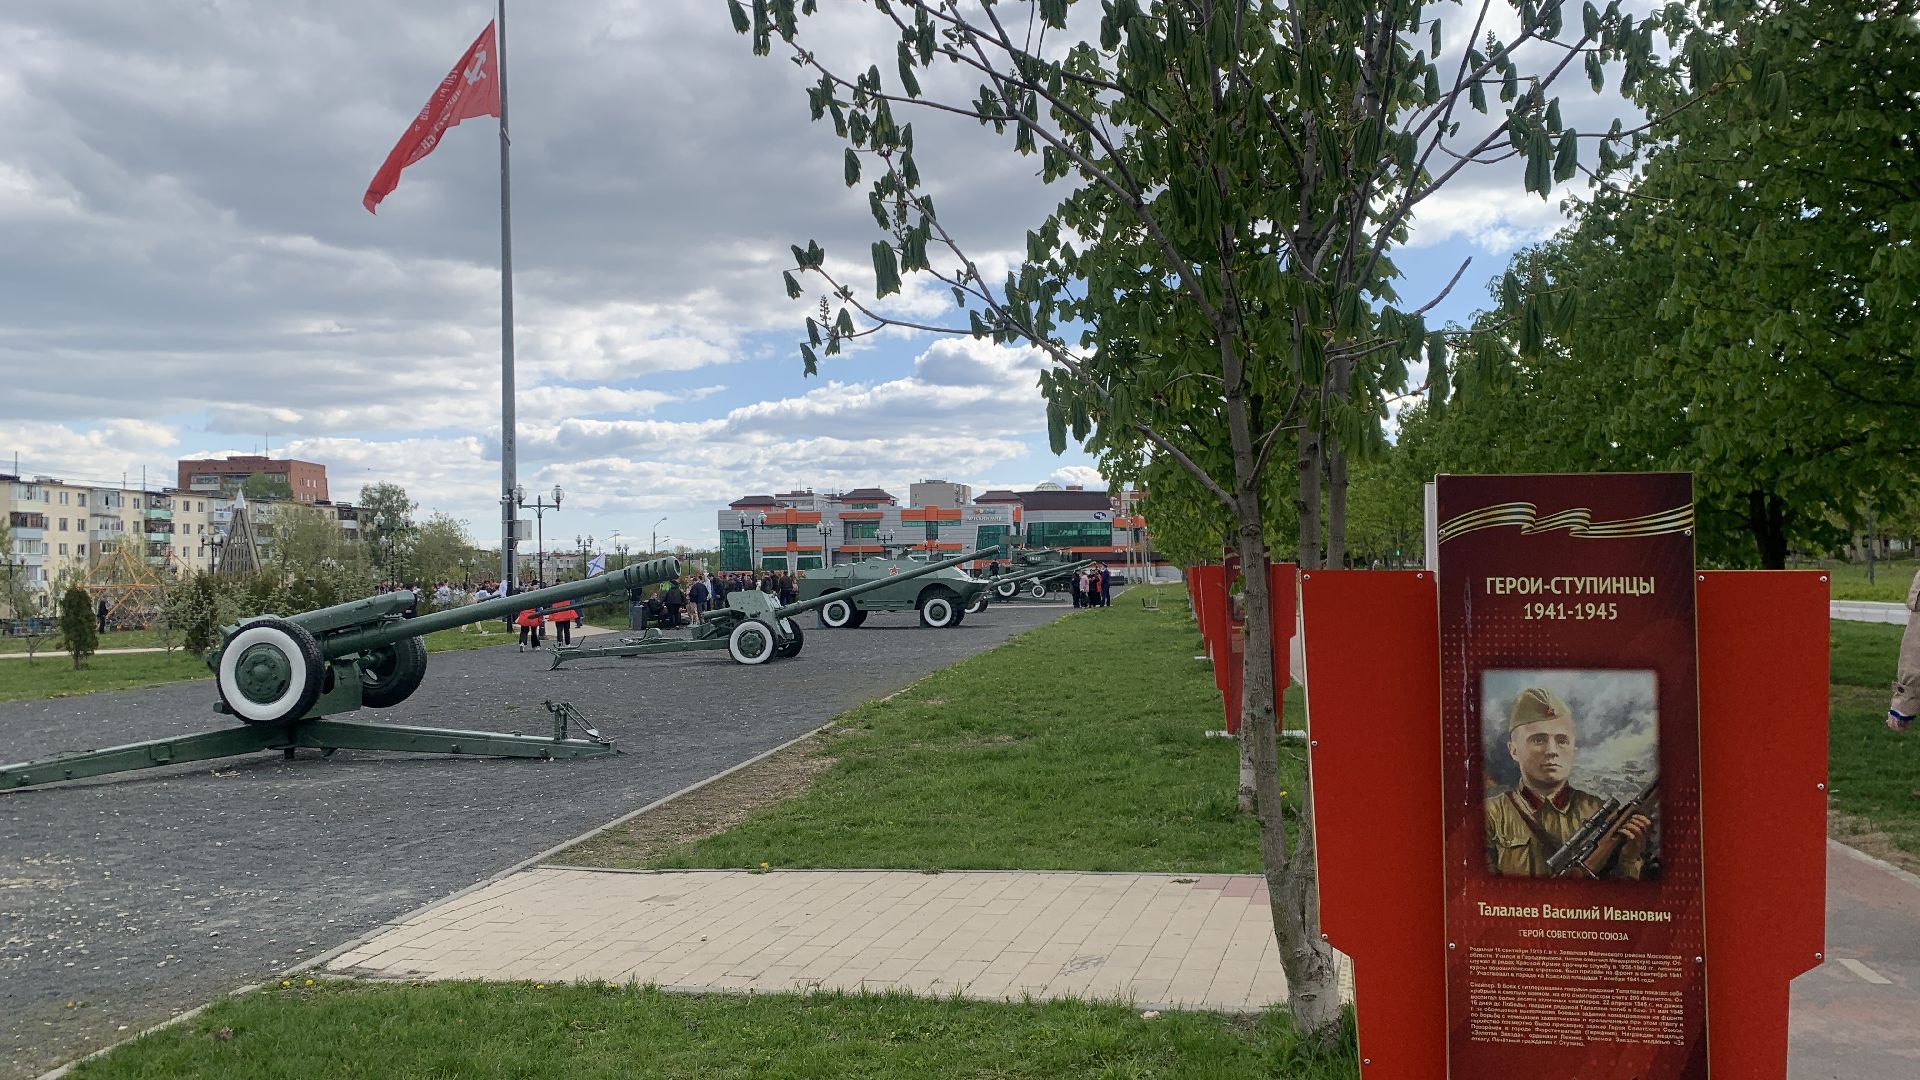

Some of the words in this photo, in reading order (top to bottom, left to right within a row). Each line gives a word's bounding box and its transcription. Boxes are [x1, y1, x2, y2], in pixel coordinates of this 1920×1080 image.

[1486, 576, 1655, 596] ГЕРОИ-СТУПИНЦЫ
[1524, 603, 1618, 620] 1941-1945
[1478, 902, 1538, 918] Талалаев
[1542, 904, 1600, 920] Василий
[1604, 906, 1671, 922] Иванович
[1518, 928, 1544, 938] ГЕРОЙ
[1546, 930, 1598, 940] СОВЕТСКОГО
[1600, 931, 1629, 941] СОЮЗА
